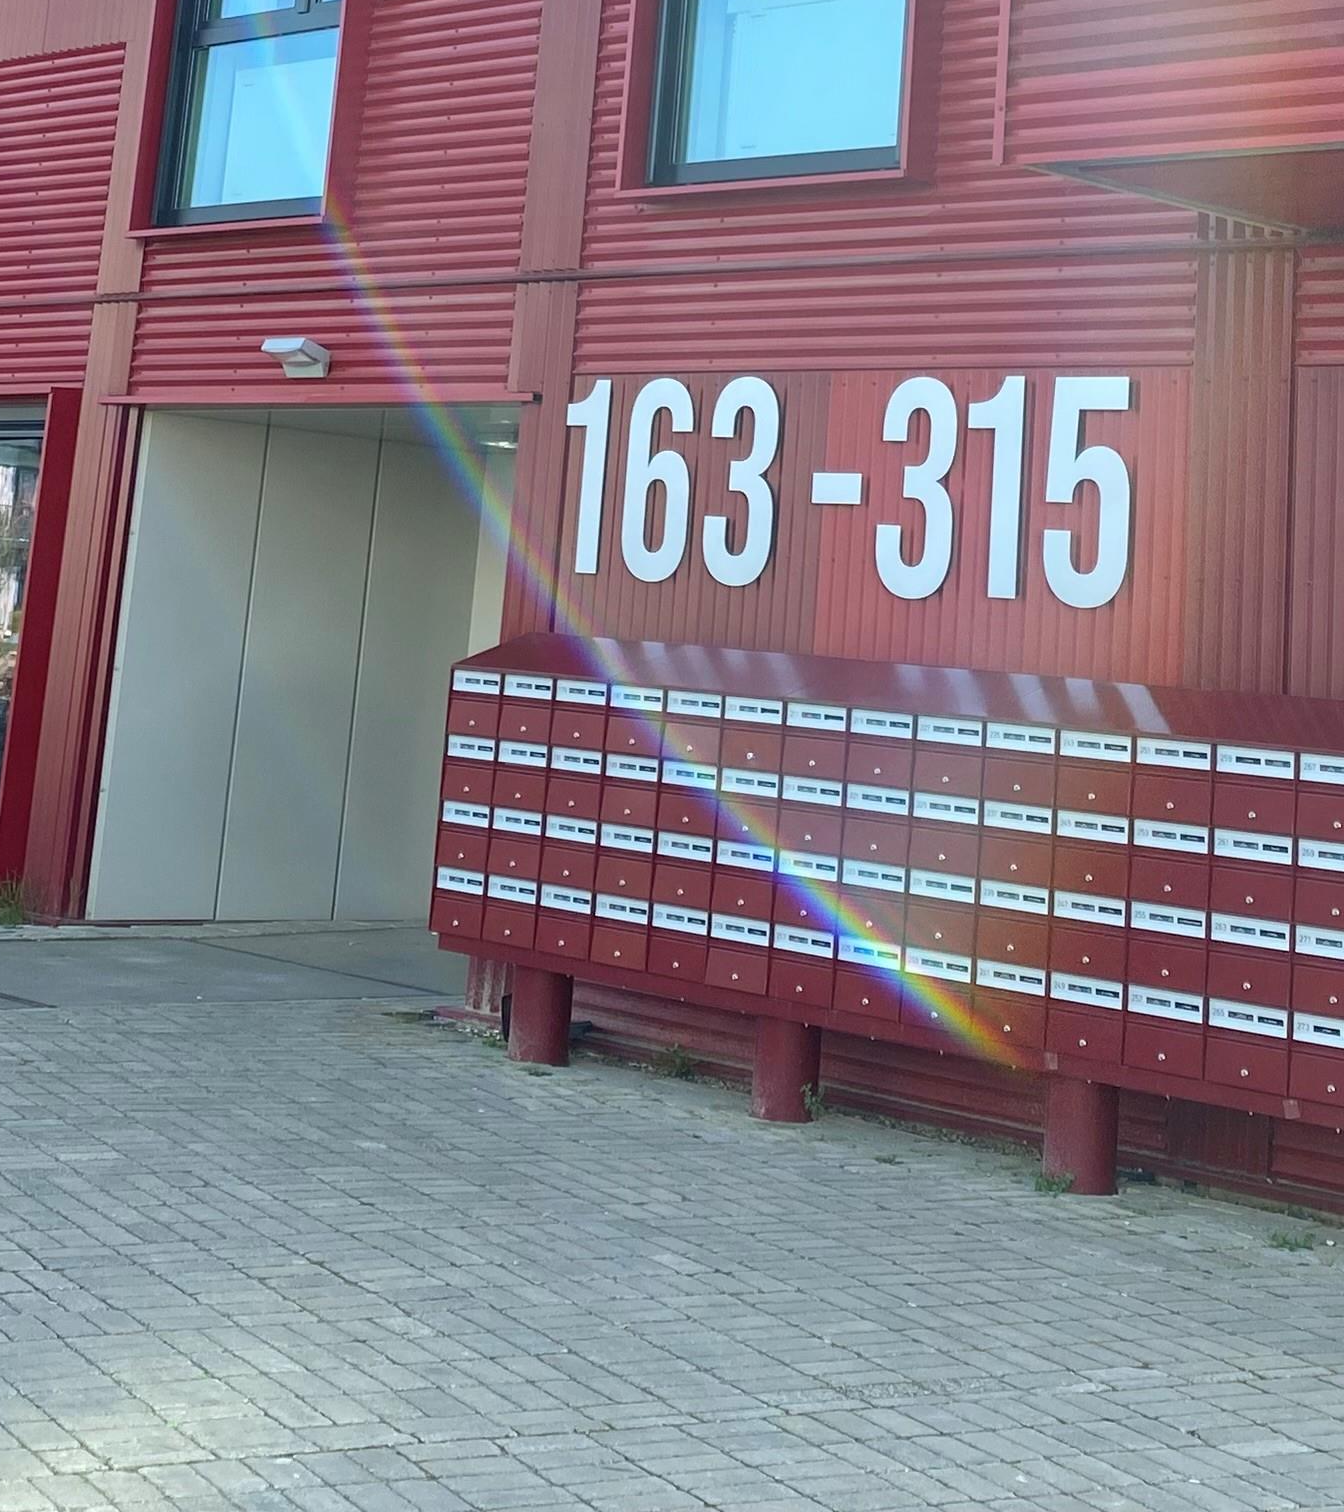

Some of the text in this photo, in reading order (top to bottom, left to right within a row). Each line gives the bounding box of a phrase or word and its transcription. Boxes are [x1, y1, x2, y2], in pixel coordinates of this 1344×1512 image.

[1304, 762, 1317, 771] 267
[1302, 848, 1315, 858] 269
[1299, 935, 1312, 944] 271
[1297, 1023, 1310, 1032] 273
